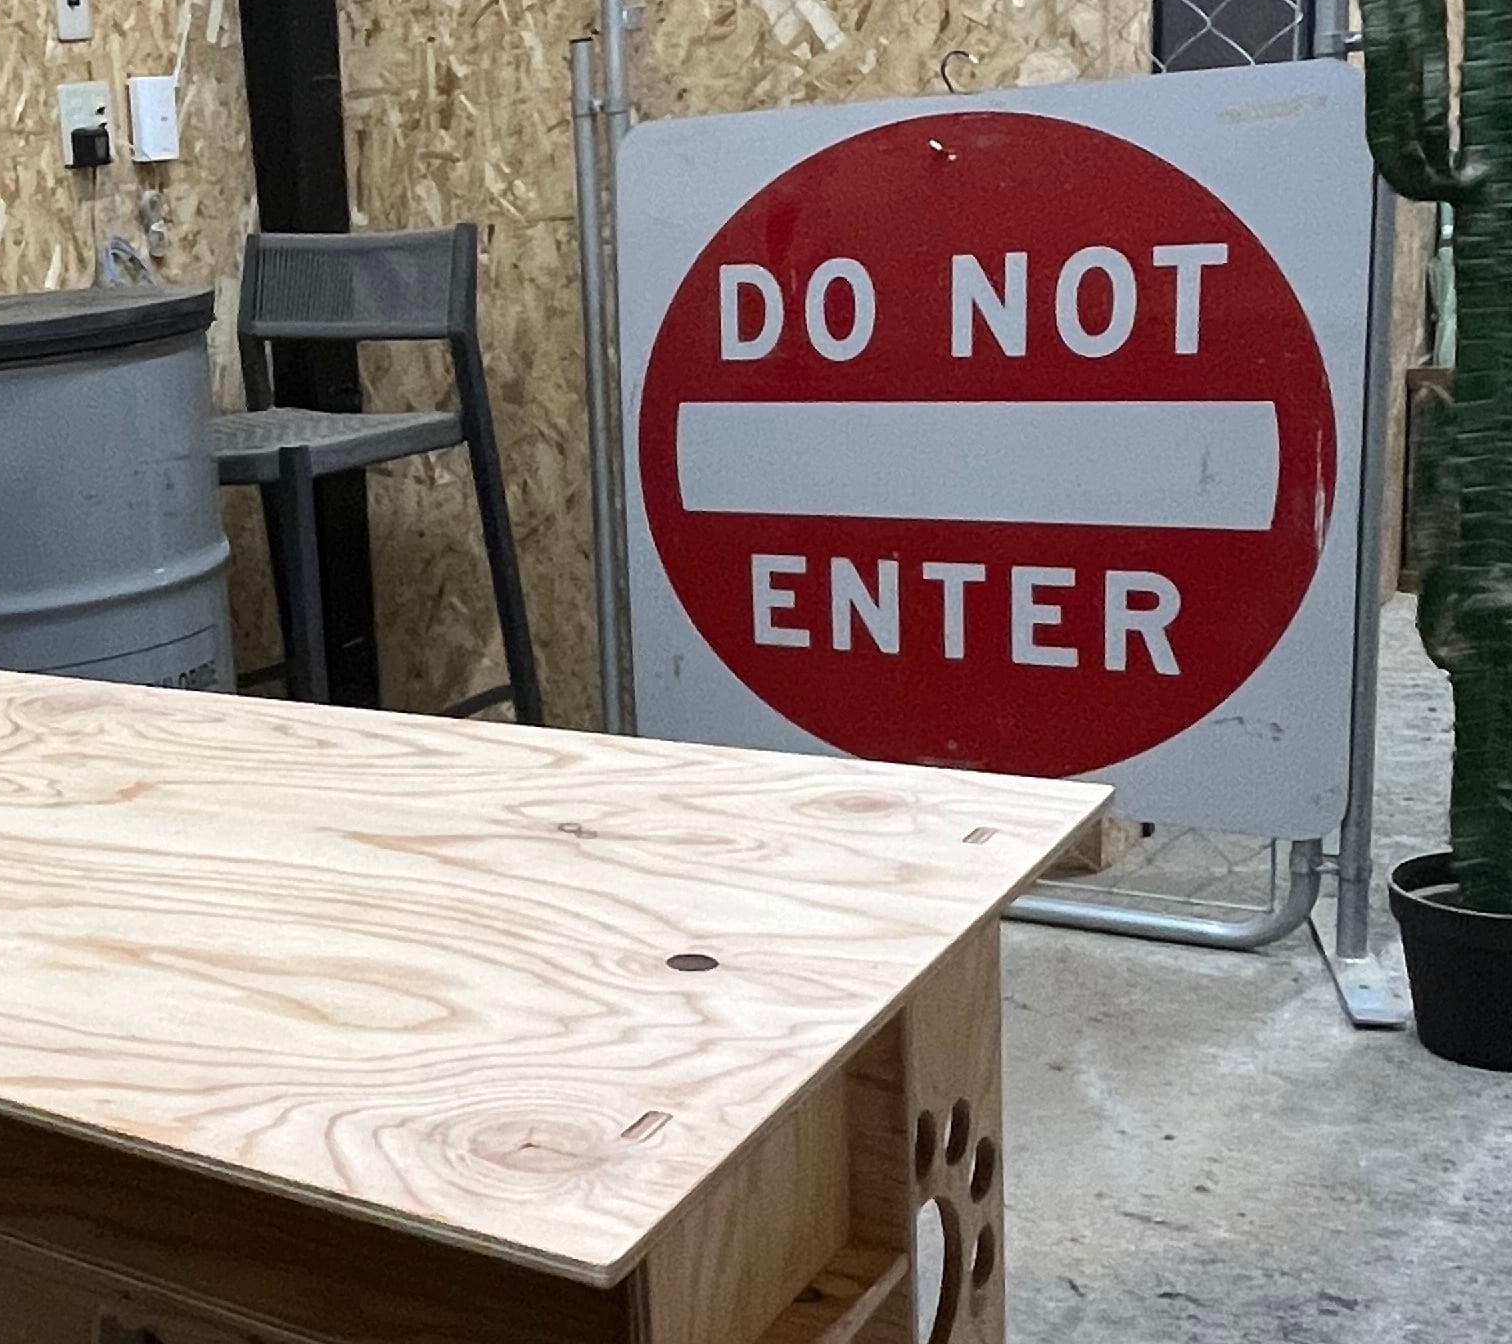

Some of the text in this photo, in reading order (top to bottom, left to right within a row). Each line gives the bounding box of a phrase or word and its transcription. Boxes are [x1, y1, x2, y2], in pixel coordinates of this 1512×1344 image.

[718, 243, 1229, 362] DO NOT
[751, 553, 1182, 676] ENTER
